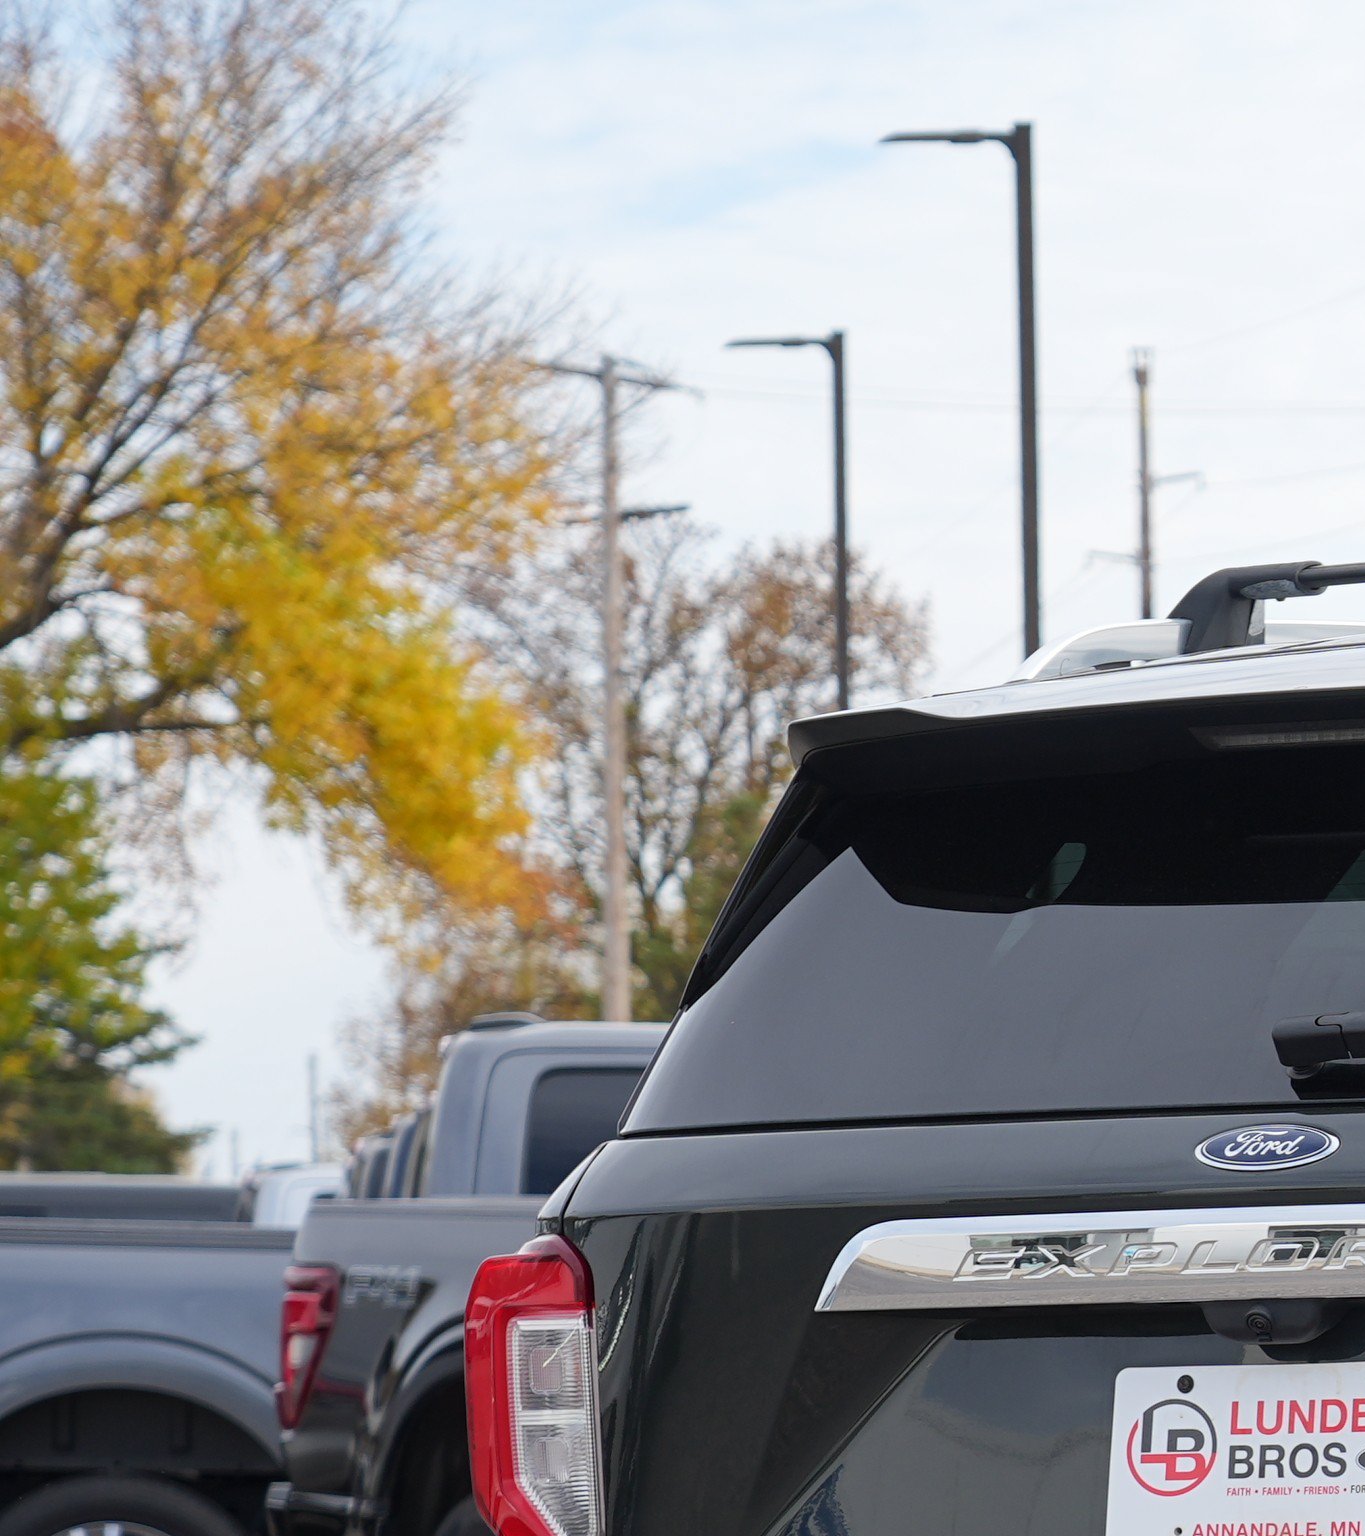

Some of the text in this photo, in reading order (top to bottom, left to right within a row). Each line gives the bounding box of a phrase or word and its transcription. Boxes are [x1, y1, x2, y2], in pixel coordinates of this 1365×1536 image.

[1223, 1130, 1306, 1157] Ford
[1227, 1442, 1348, 1480] BROS
[1226, 1487, 1252, 1497] FAITH
[1262, 1486, 1293, 1497] FAMILY
[1303, 1485, 1341, 1496] FRIENDS
